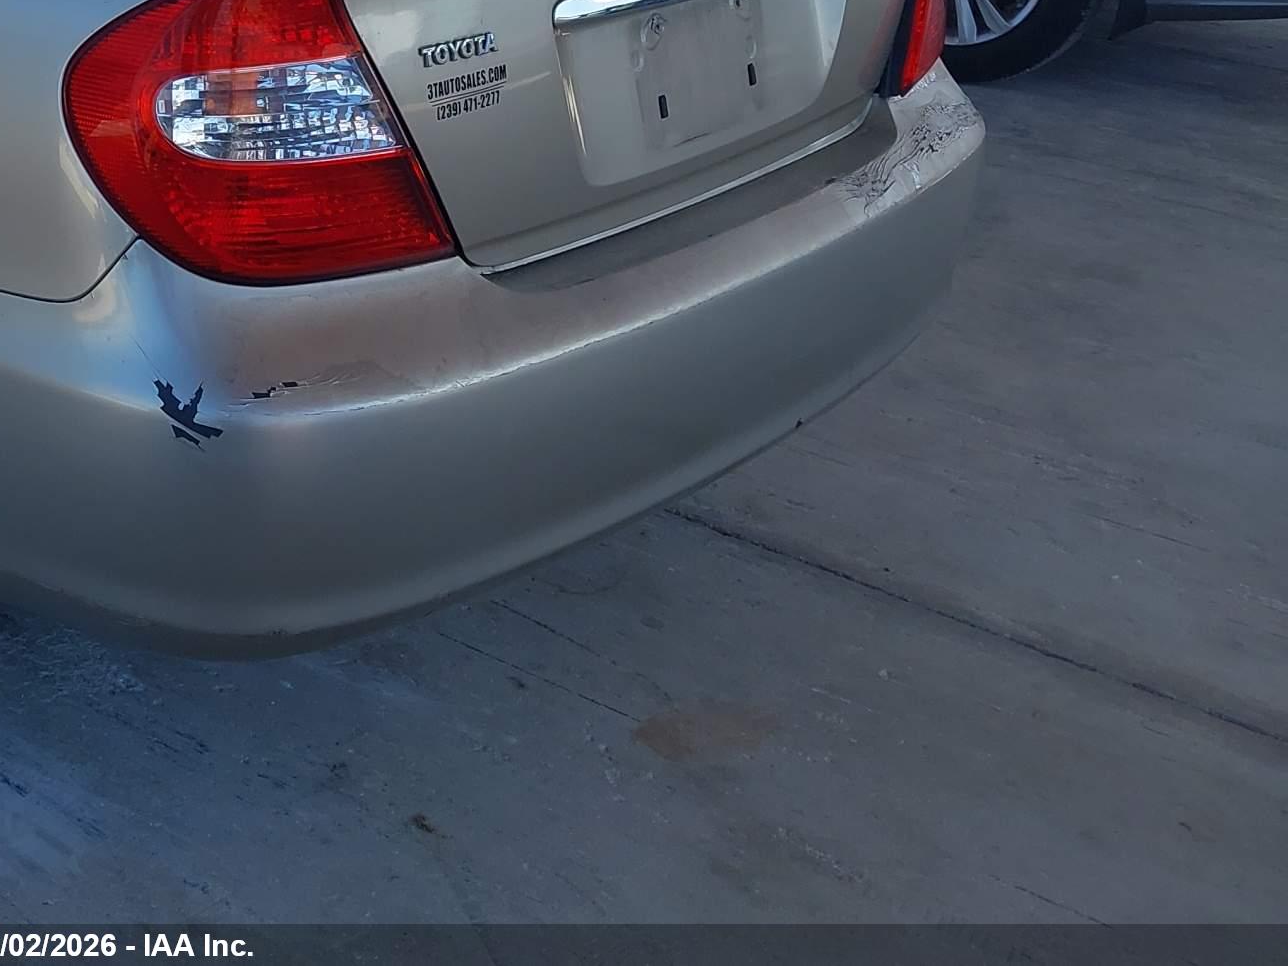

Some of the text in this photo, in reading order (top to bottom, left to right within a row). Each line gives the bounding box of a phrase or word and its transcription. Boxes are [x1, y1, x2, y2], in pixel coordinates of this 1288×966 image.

[418, 32, 498, 68] TOYOTA
[427, 64, 507, 100] 3TAUTOSALES.COM
[436, 90, 500, 121] (239) 471-2277
